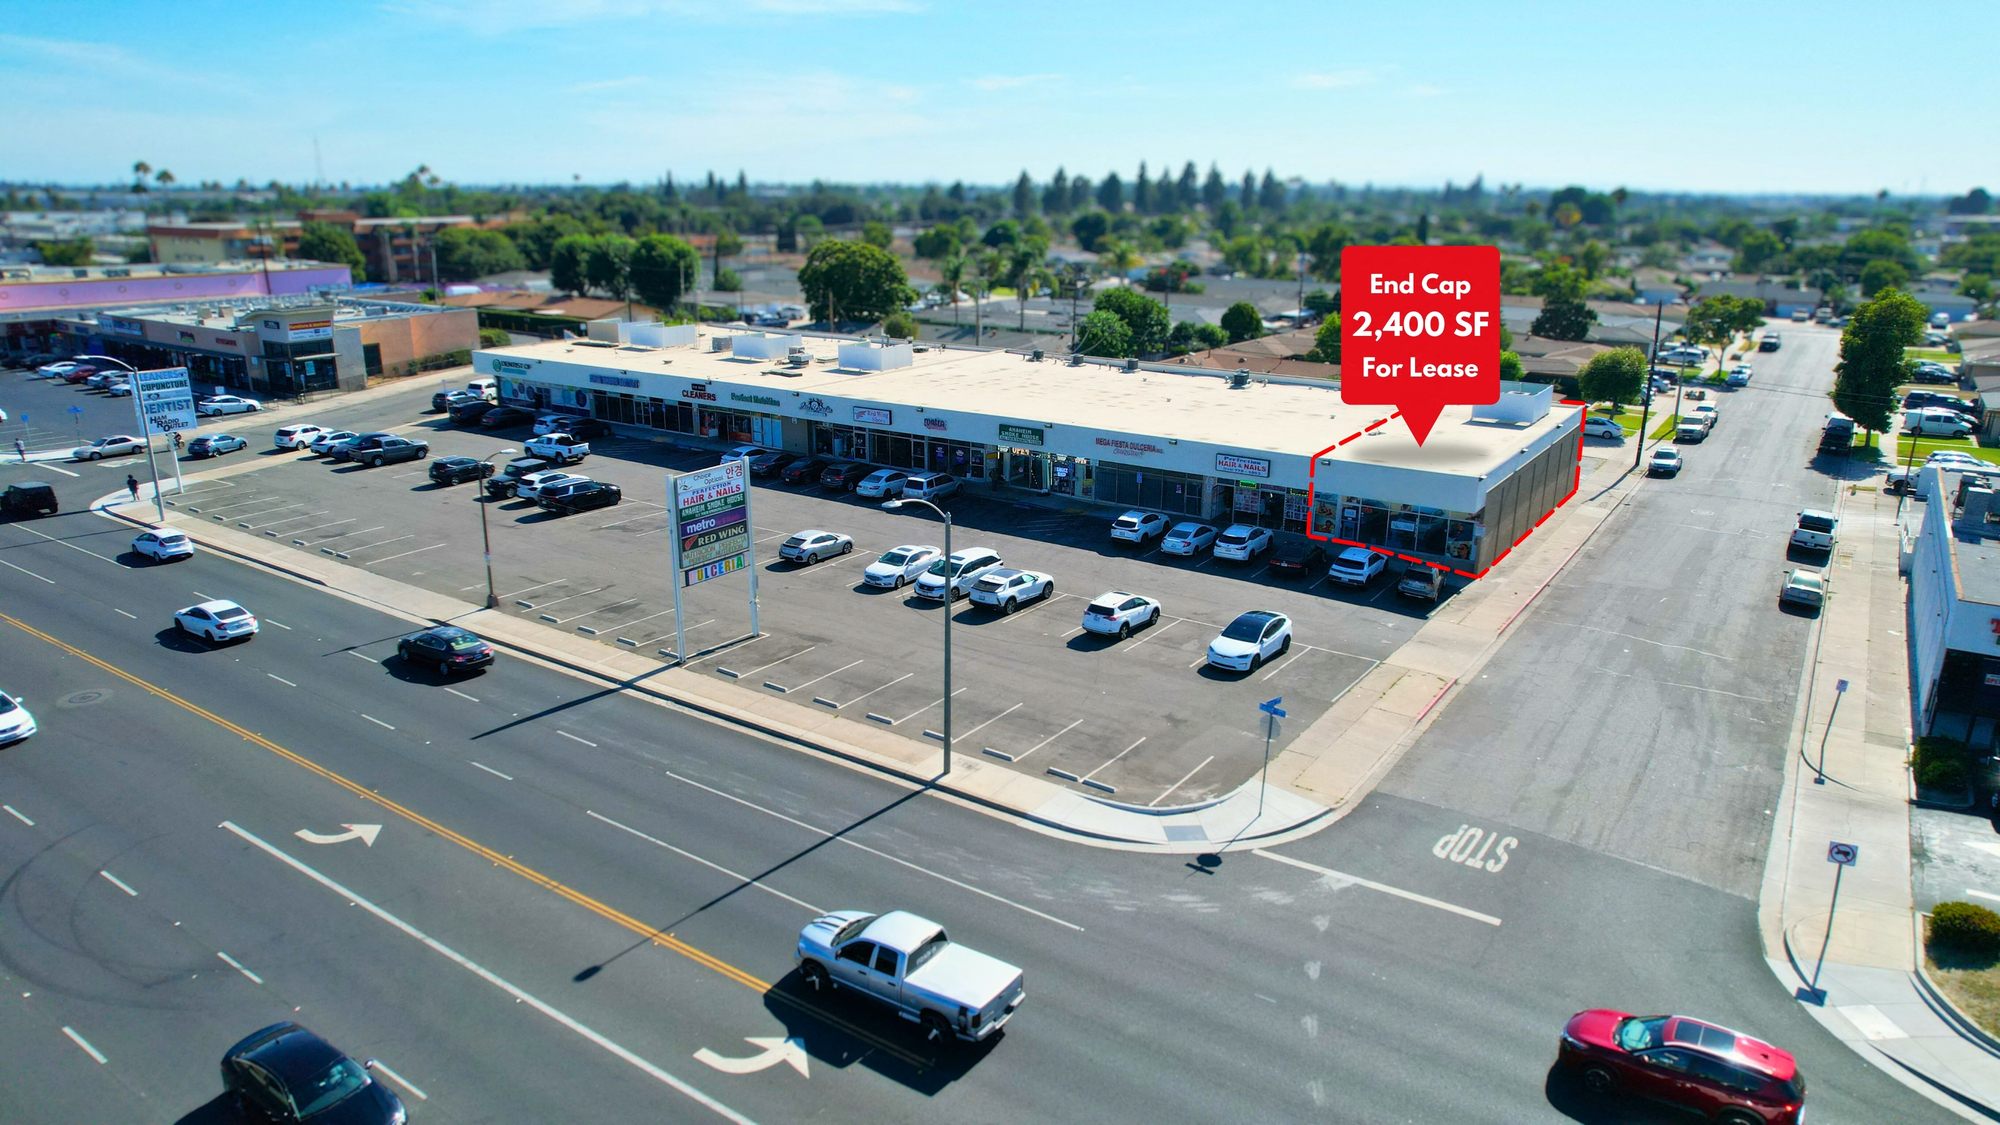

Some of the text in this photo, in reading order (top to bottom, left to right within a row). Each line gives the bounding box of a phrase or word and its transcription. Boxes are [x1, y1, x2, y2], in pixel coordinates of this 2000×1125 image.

[140, 370, 179, 382] LEANERS
[141, 380, 188, 392] CUPUNCTURE
[681, 389, 716, 402] CLEANERS
[144, 399, 191, 415] DENTIST
[150, 414, 168, 425] HAM
[156, 417, 180, 429] RADIO
[162, 421, 189, 433] OUTLET
[1008, 426, 1032, 435] ANAHEIM
[1001, 430, 1019, 438] SMOKE
[1095, 437, 1110, 447] MEGA
[1110, 439, 1129, 449] FIESTA
[1129, 441, 1156, 453] DULCERIA
[1218, 460, 1237, 468] HAIR
[1243, 464, 1267, 473] NAILS
[1223, 456, 1262, 466] Perfection
[693, 472, 712, 482] Choice
[725, 463, 743, 480] 안경
[704, 475, 724, 485] Optical
[692, 480, 732, 496] PERFECTION
[682, 483, 741, 507] HAIR & NAILS
[681, 503, 706, 518] ANAHEIM
[707, 498, 725, 511] SMOKE
[726, 493, 744, 505] HOUSE
[686, 518, 716, 535] metro
[697, 524, 745, 547] RED WING
[688, 555, 744, 585] DULCERIA
[1432, 824, 1519, 873] STOP
